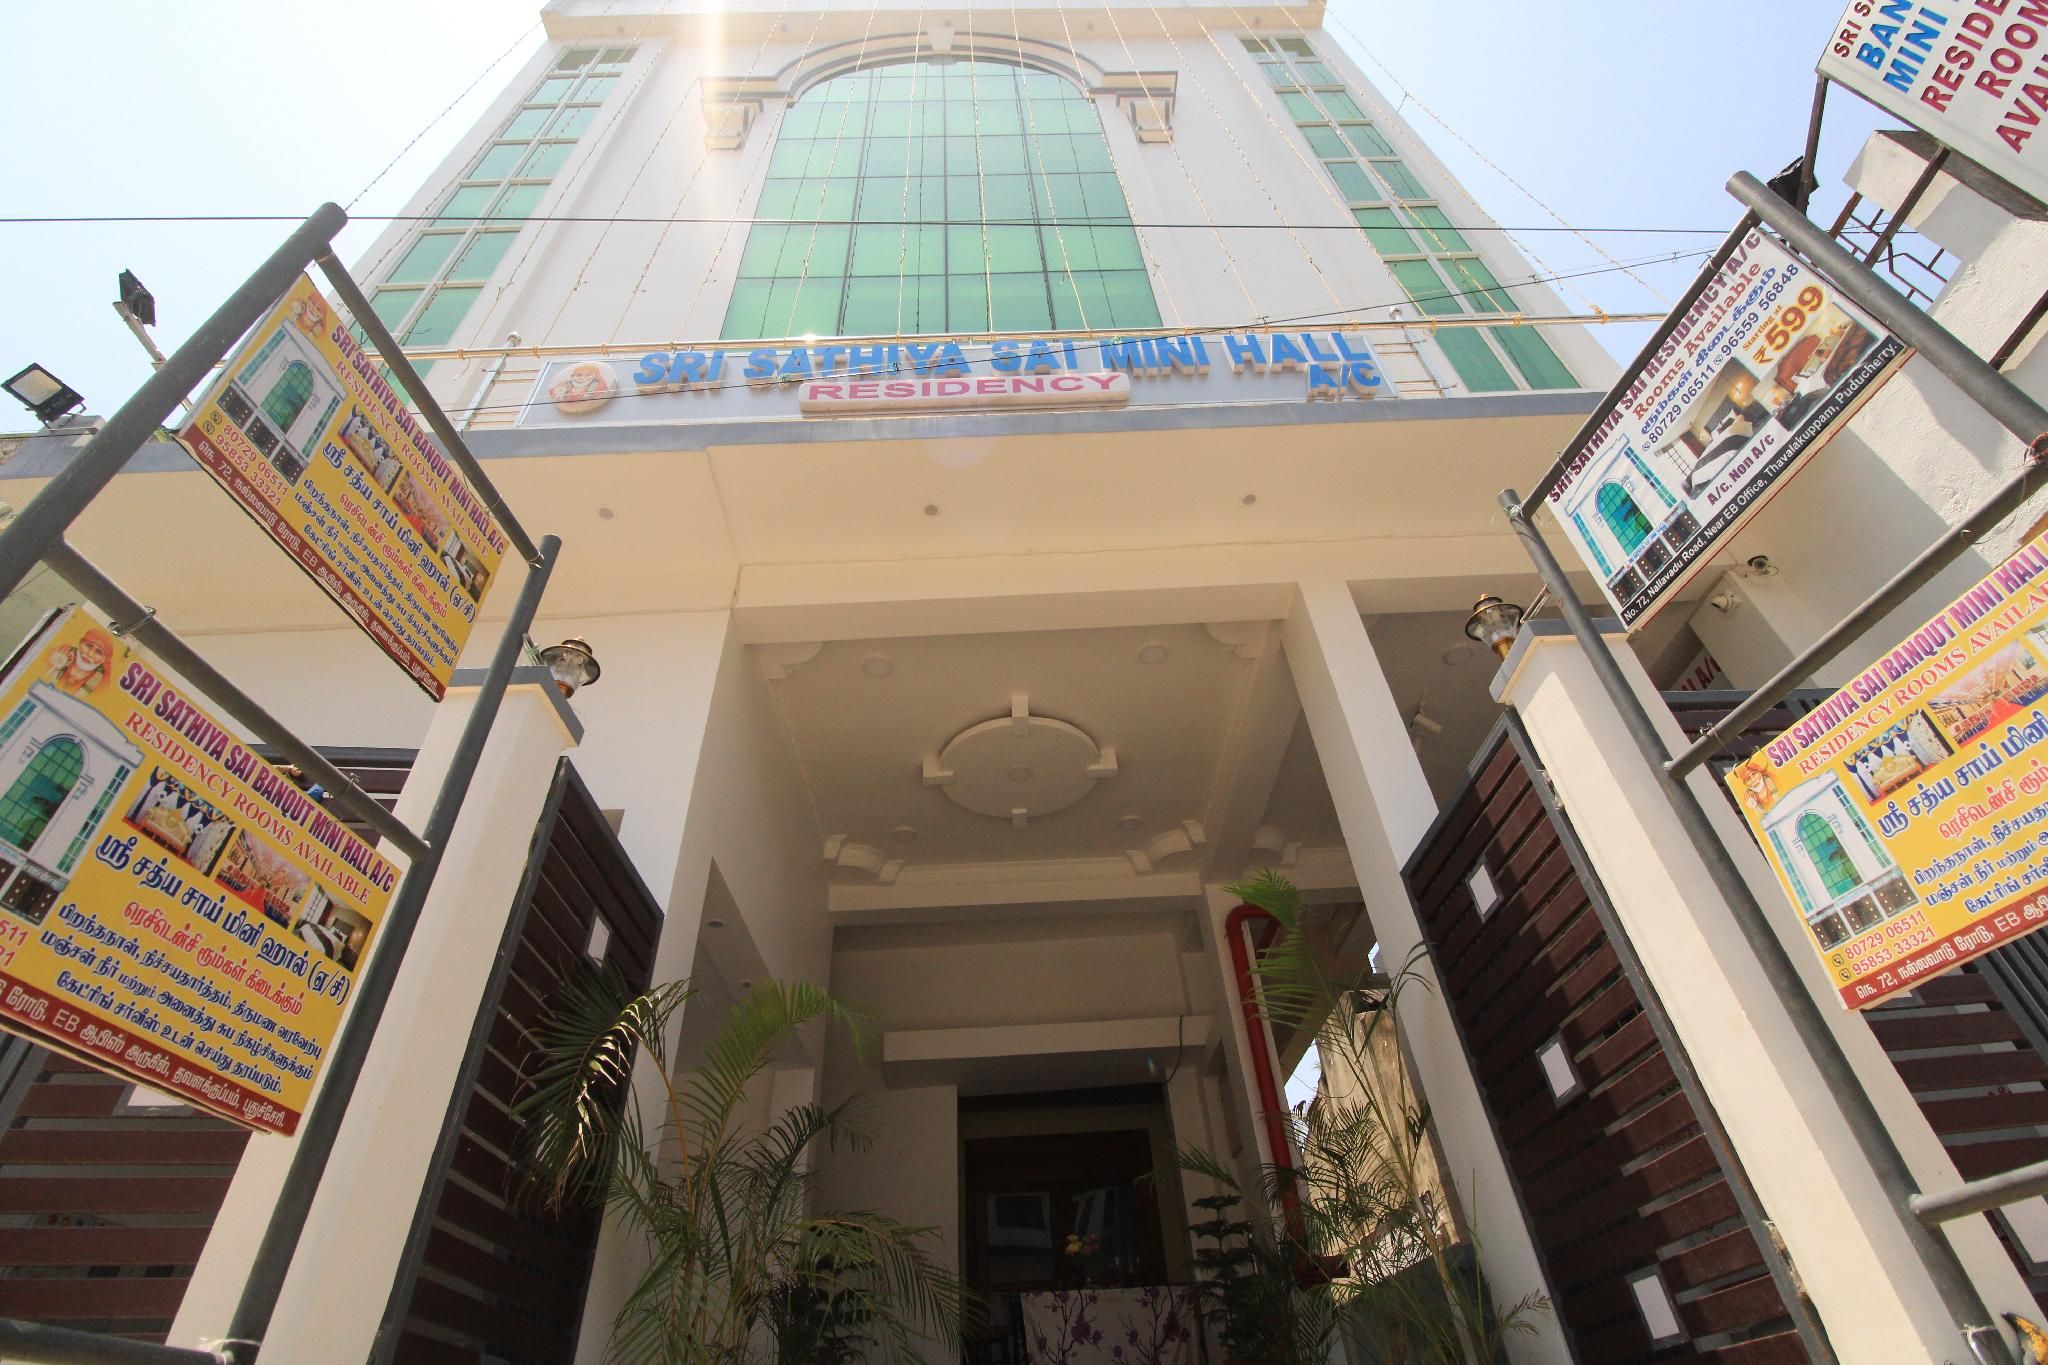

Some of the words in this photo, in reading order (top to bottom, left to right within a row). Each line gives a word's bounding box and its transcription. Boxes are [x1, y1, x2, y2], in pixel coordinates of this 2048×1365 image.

[1834, 20, 1862, 58] SRI
[1883, 7, 1948, 94] MINI
[633, 350, 725, 385] SRI
[743, 342, 972, 381] SATHIYA
[990, 338, 1078, 374] SAI
[1102, 335, 1210, 374] MINI
[1223, 332, 1372, 370] HALL
[1631, 357, 1685, 421] Rooms
[1682, 262, 1761, 359] Available
[1647, 403, 1682, 444] 80729
[1679, 363, 1715, 405] 06511
[1719, 311, 1759, 357] 96559
[1757, 262, 1799, 311] 56848
[1741, 314, 1774, 349] Starting
[1772, 303, 1783, 316] at
[808, 374, 1122, 402] RESIDENCY
[1309, 362, 1381, 393] A/C
[1548, 471, 1573, 503] SRI
[1568, 405, 1624, 476] SATHIYA
[1618, 374, 1648, 410] SAI
[1643, 270, 1728, 379] RESIDENCY
[222, 423, 257, 462] 80729
[256, 460, 289, 496] 06511
[330, 324, 356, 359] SRI
[351, 350, 398, 416] SATHIYA
[393, 406, 416, 438] SAI
[410, 429, 453, 484] BANQUT
[447, 476, 472, 512] MINI
[467, 502, 490, 537] HALL
[334, 359, 402, 444] RESIDENCY
[400, 442, 438, 494] ROOMS
[441, 493, 489, 555] AVAILABLE
[214, 433, 250, 473] 95853
[249, 470, 282, 507] 33321
[1622, 607, 1638, 622] No.
[1635, 594, 1650, 609] 72,
[1646, 558, 1684, 598] Nallavadu
[1681, 535, 1707, 562] Road,
[1703, 516, 1725, 539] Near
[1722, 502, 1739, 520] EB
[1735, 478, 1768, 506] Office,
[1762, 404, 1840, 477] Thavalakuppam,
[1833, 342, 1896, 404] Puducherry.
[1727, 455, 1754, 483] Non
[301, 547, 318, 567] EB
[1766, 734, 1798, 768] SRI
[1791, 690, 1860, 749] SATHIYA
[1851, 667, 1888, 703] SAI
[1879, 615, 1956, 682] BANQUT
[1948, 579, 2004, 630] MINI
[1797, 703, 1892, 775] RESIDENCY
[1892, 651, 1966, 706] ROOMS
[118, 661, 162, 706] SRI
[153, 689, 229, 762] SATHIYA
[223, 743, 258, 783] SAI
[250, 764, 315, 827] BANQUT
[307, 810, 346, 853] MINI
[339, 835, 374, 877] HALL
[1953, 741, 2003, 787] சாய்
[124, 710, 230, 799] RESIDENCY
[232, 791, 291, 846] ROOMS
[297, 840, 368, 905] AVAILABLE
[180, 885, 226, 924] சாய்
[220, 909, 265, 947] மினி
[1843, 931, 1884, 960] 80729
[1884, 909, 1926, 939] 06511
[1850, 947, 1893, 976] 95853
[1892, 925, 1936, 955] 33321
[1876, 970, 1898, 989] 72,
[1993, 910, 2021, 933] EB
[51, 1008, 81, 1033] EB
